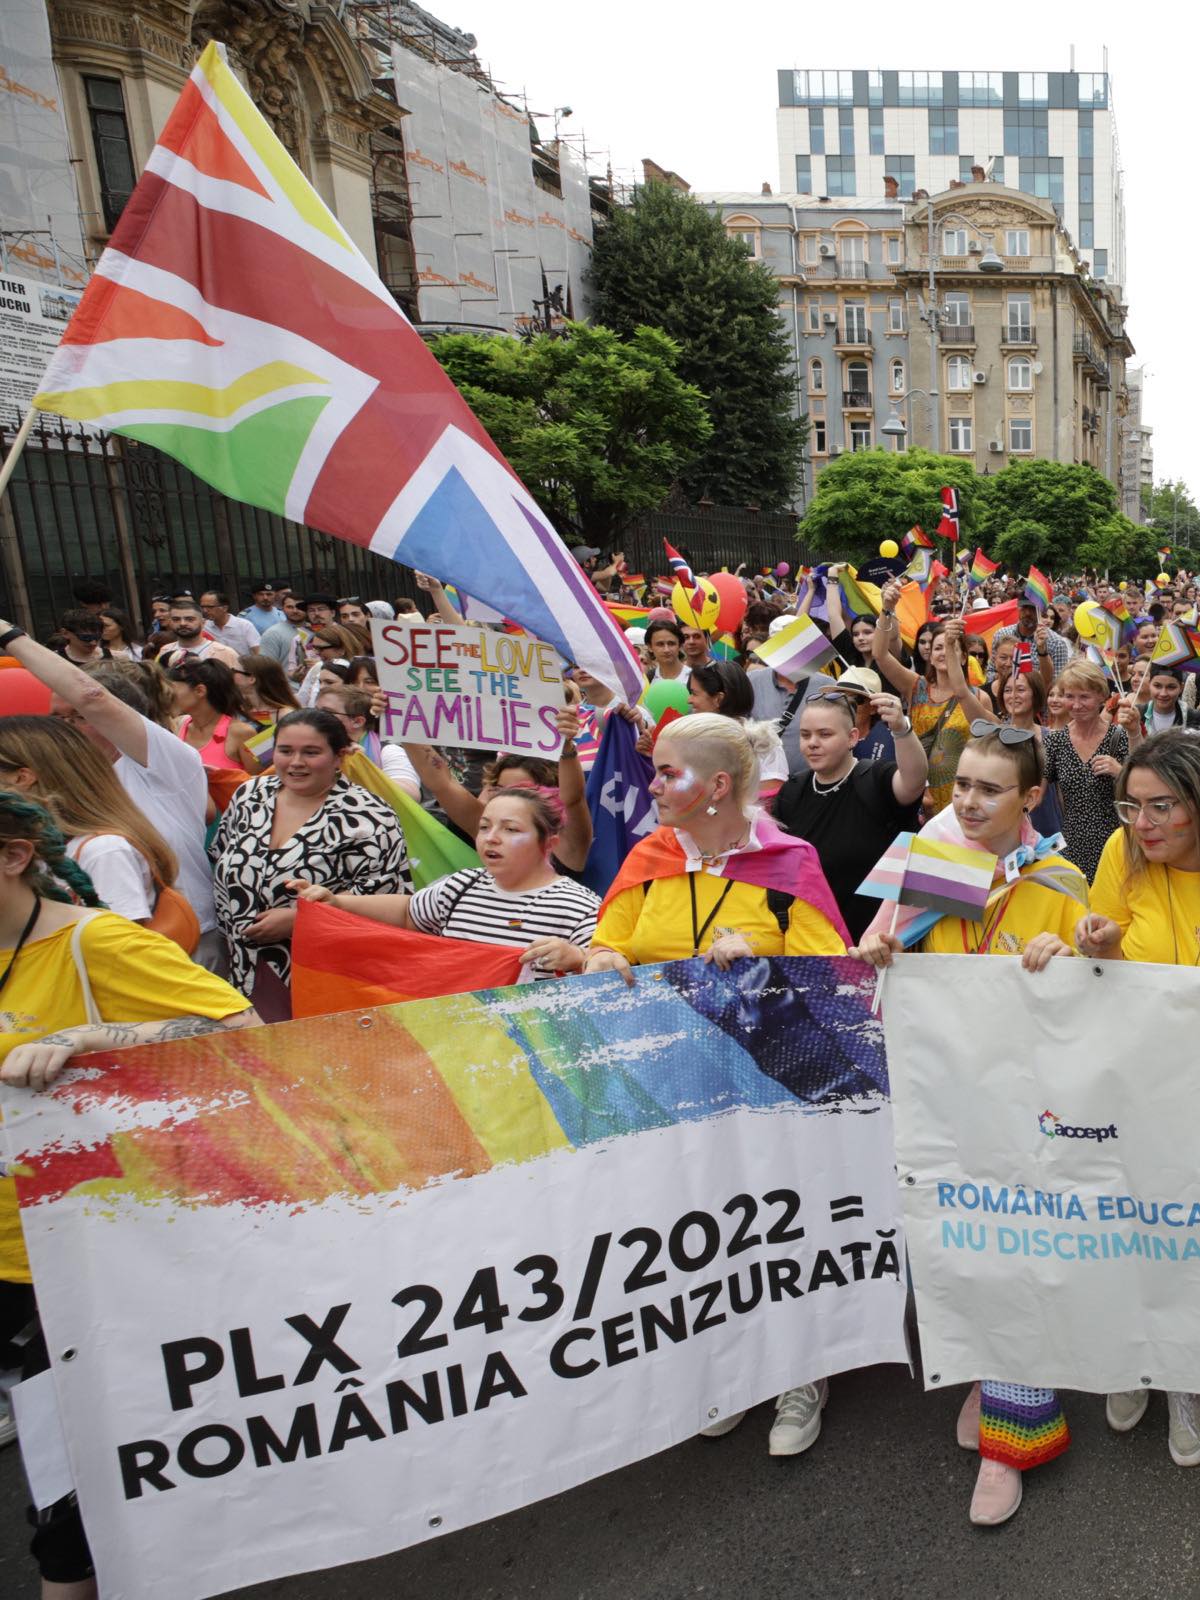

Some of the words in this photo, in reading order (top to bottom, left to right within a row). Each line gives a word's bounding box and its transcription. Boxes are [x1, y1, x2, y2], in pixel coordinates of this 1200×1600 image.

[382, 625, 459, 669] SEE
[452, 642, 481, 658] THE
[479, 632, 560, 683] LOVE
[406, 667, 461, 693] SEE
[469, 670, 523, 699] THE
[1054, 1123, 1118, 1143] accept
[937, 1182, 1088, 1221] ROMÂNIA
[941, 1220, 986, 1252] NU
[161, 1302, 362, 1411] PLX
[391, 1188, 806, 1359] 243/2022
[829, 1195, 865, 1222] =
[117, 1351, 528, 1500] ROMÂNIA
[549, 1228, 900, 1379] CENZURATĂ
